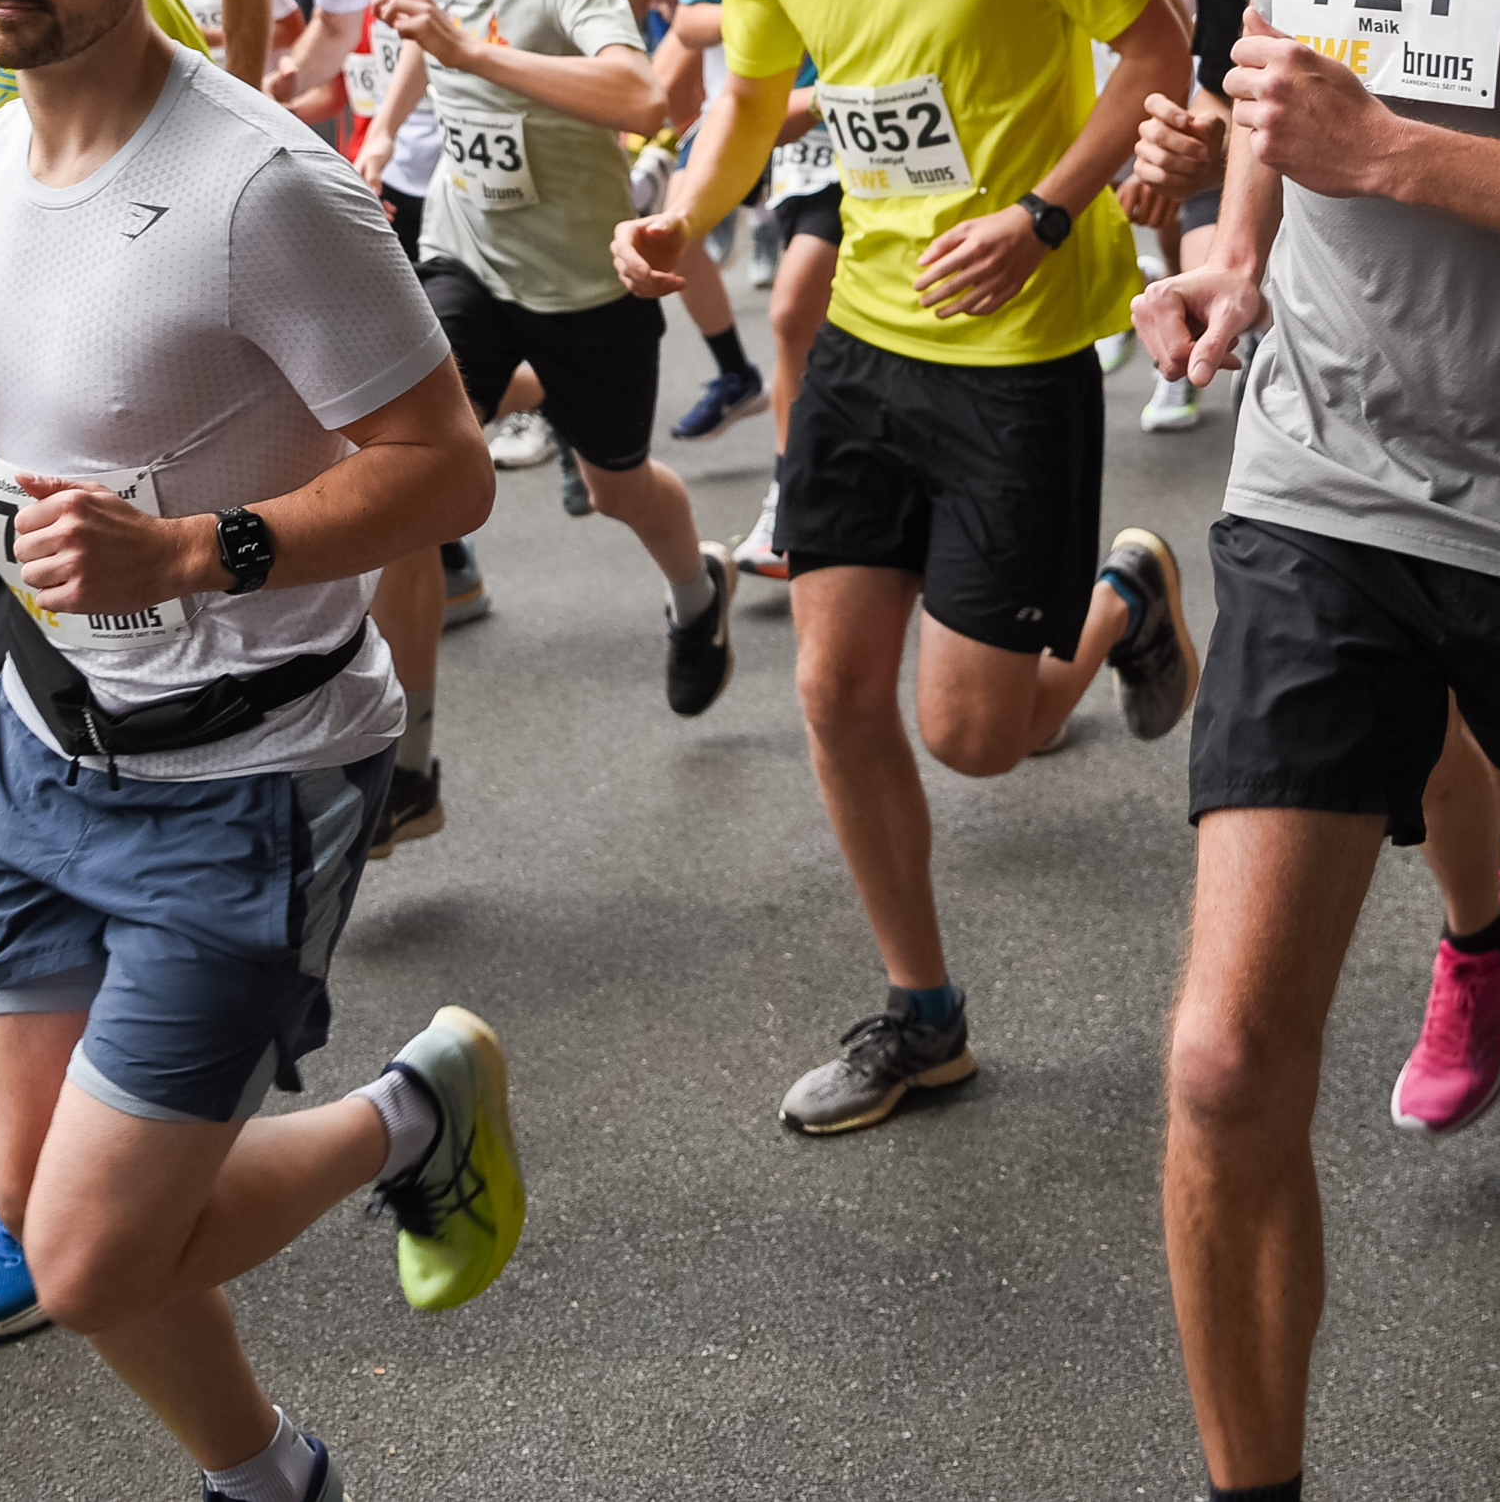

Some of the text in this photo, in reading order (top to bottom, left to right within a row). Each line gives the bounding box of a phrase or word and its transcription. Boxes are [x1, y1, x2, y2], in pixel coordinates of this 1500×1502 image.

[1358, 17, 1400, 35] Maik
[1403, 41, 1474, 82] bruns
[828, 102, 951, 153] 1652
[905, 166, 955, 184] bruns
